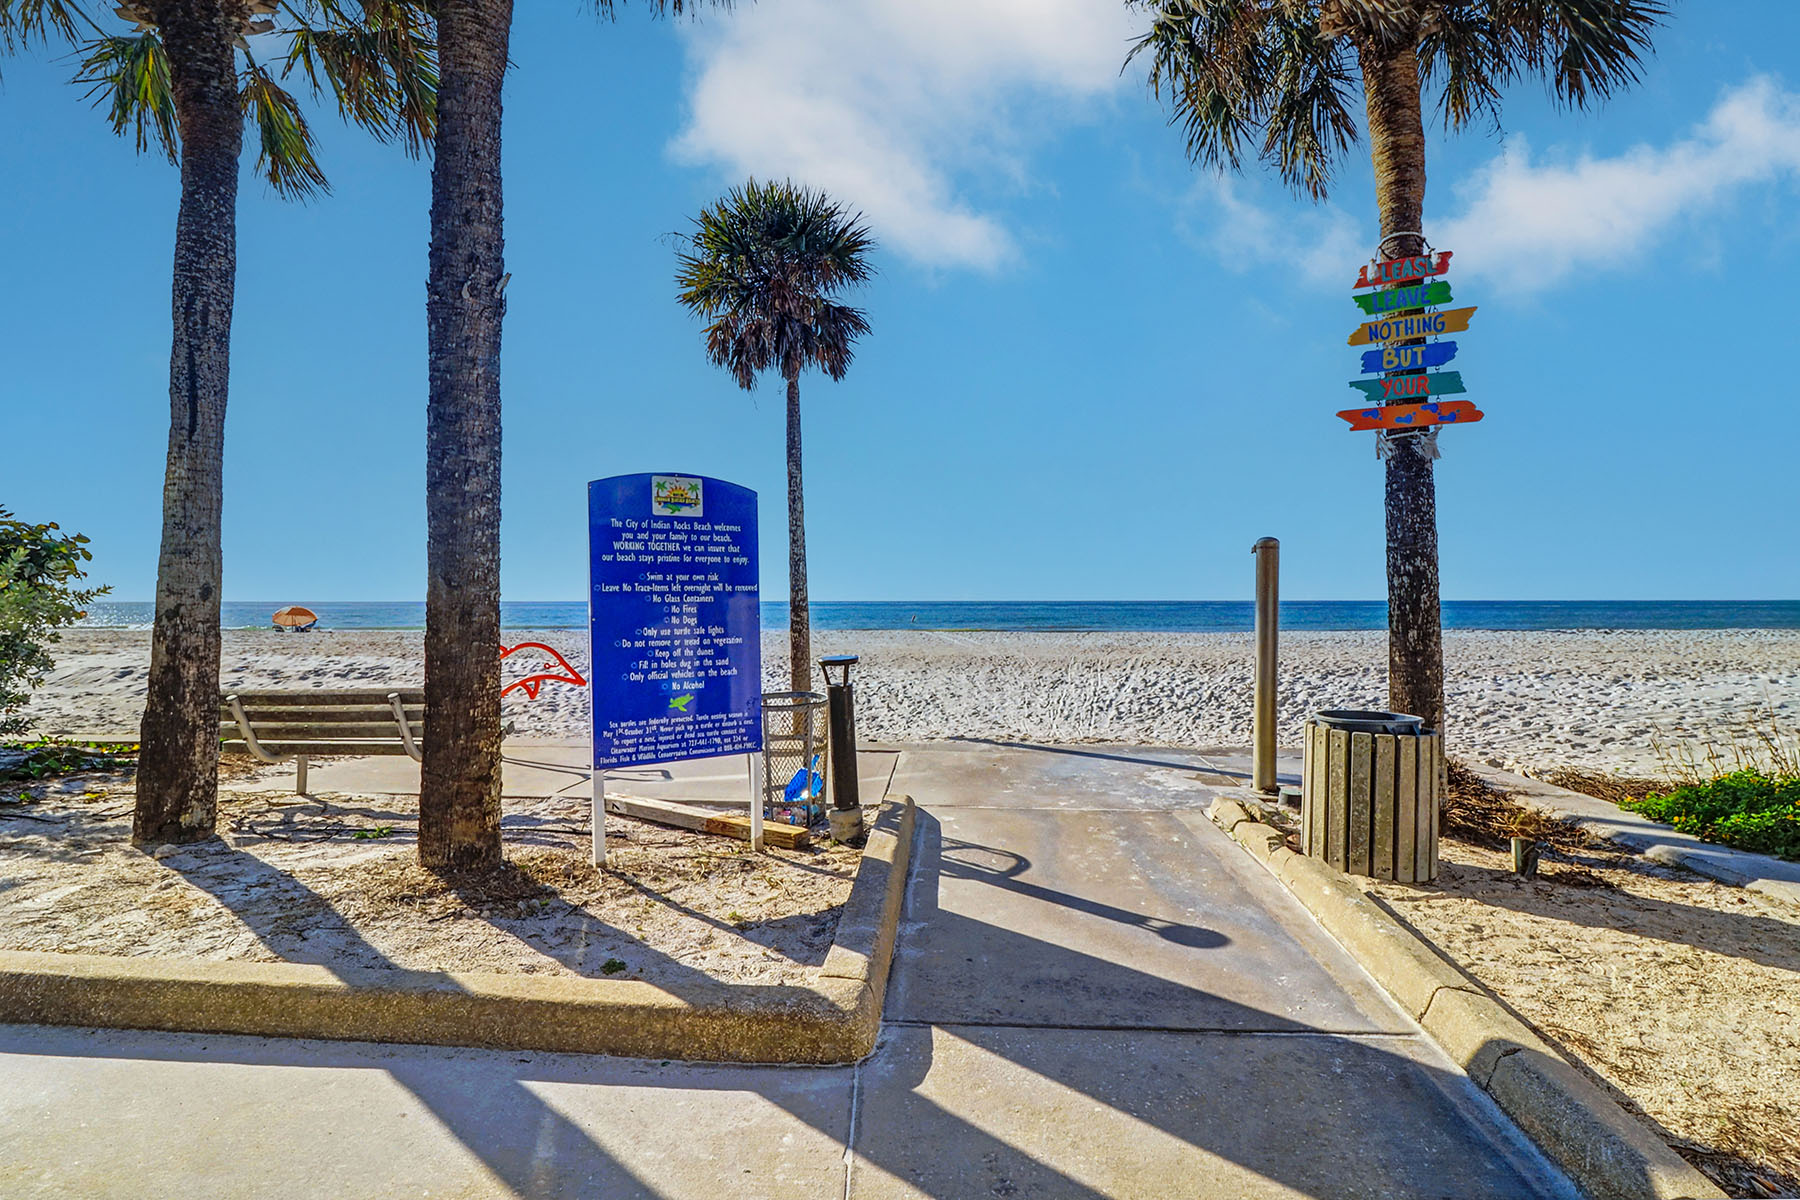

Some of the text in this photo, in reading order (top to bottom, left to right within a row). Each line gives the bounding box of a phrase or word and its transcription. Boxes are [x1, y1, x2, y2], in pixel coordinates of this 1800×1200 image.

[1372, 285, 1431, 311] LEAVE
[1368, 313, 1446, 341] NOTHING
[1382, 346, 1426, 369] BUT
[1380, 375, 1431, 398] YOUR
[611, 518, 741, 532] The City of Indian Rocks Beach welcomes
[622, 532, 633, 541] you
[637, 531, 649, 539] and
[652, 533, 666, 542] your
[669, 532, 688, 543] family
[713, 533, 732, 542] beach.
[613, 541, 645, 551] WORKING
[648, 542, 680, 551] TOGETHER
[708, 543, 725, 552] insure
[728, 544, 740, 552] that
[616, 552, 636, 562] beach
[639, 554, 654, 564] stays
[657, 553, 680, 564] pristine
[683, 554, 692, 562] for
[695, 555, 721, 565] everyone
[733, 555, 749, 566] enjoy.
[647, 571, 663, 580] Swim
[676, 574, 690, 583] your
[708, 572, 719, 581] risk
[602, 583, 620, 592] Leave
[623, 583, 632, 592] No
[672, 583, 681, 592] left
[684, 583, 711, 594] overnight
[713, 583, 723, 591] will
[725, 583, 732, 591] be
[653, 593, 714, 602] No Glass Containers
[671, 604, 697, 613] No Fires
[671, 615, 697, 626] No Dogs
[643, 627, 657, 638] Only
[674, 627, 690, 635] turtle
[708, 626, 724, 636] lights
[622, 639, 631, 648] Do
[684, 637, 700, 646] tread
[713, 636, 743, 646] vegetation
[655, 649, 670, 660] Keep
[673, 648, 681, 657] off
[684, 647, 693, 656] the
[639, 657, 729, 669] Fill in holes dug in the sand
[630, 672, 644, 683] Only
[647, 671, 668, 680] official
[671, 670, 695, 678] vehicles
[708, 668, 717, 676] the
[720, 667, 738, 676] beach
[672, 681, 704, 690] No Alcohol
